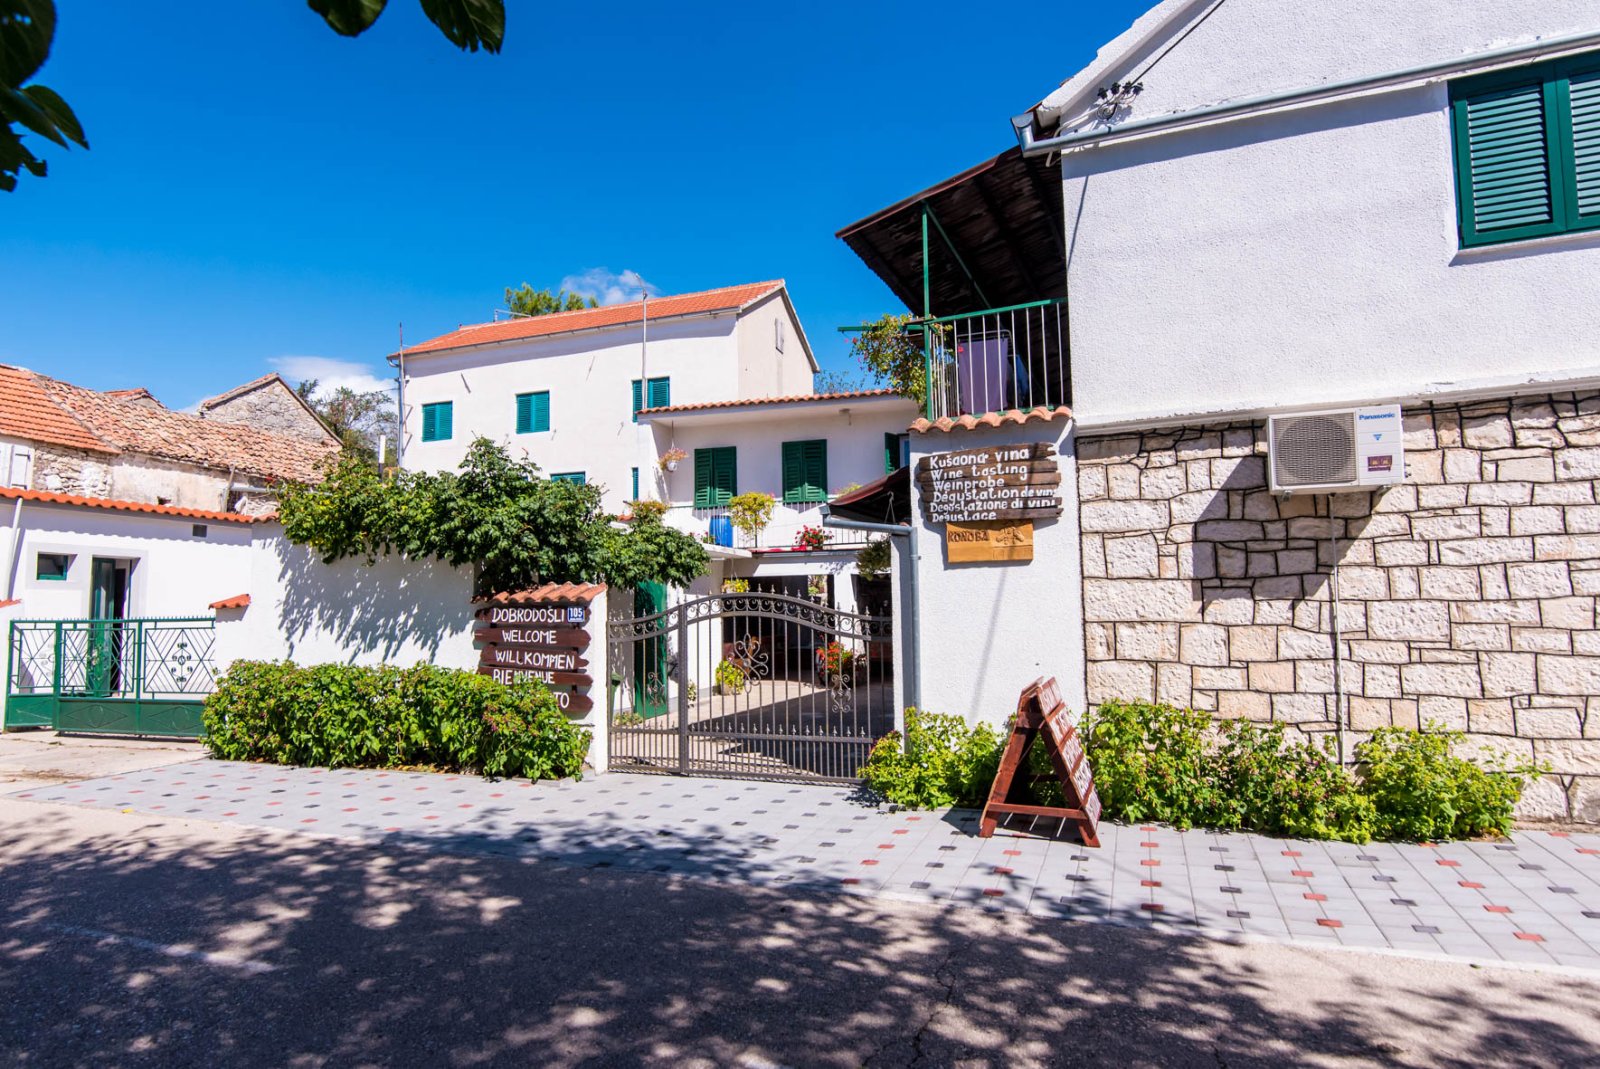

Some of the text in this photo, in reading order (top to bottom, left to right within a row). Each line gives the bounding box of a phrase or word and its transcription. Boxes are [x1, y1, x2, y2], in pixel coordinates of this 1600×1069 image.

[995, 449, 1029, 462] vina
[931, 463, 1028, 481] Wine tasting
[933, 476, 1004, 493] Weinprobe
[1021, 486, 1034, 497] de
[930, 500, 1007, 514] Degustazione
[1011, 497, 1023, 509] di
[932, 511, 997, 523] Degustace
[948, 530, 989, 542] KONOBA
[492, 606, 564, 623] DOBRODOŠLI
[570, 607, 583, 617] 105
[502, 629, 557, 644] WELCOME
[495, 650, 575, 669] WILLKOMMEN
